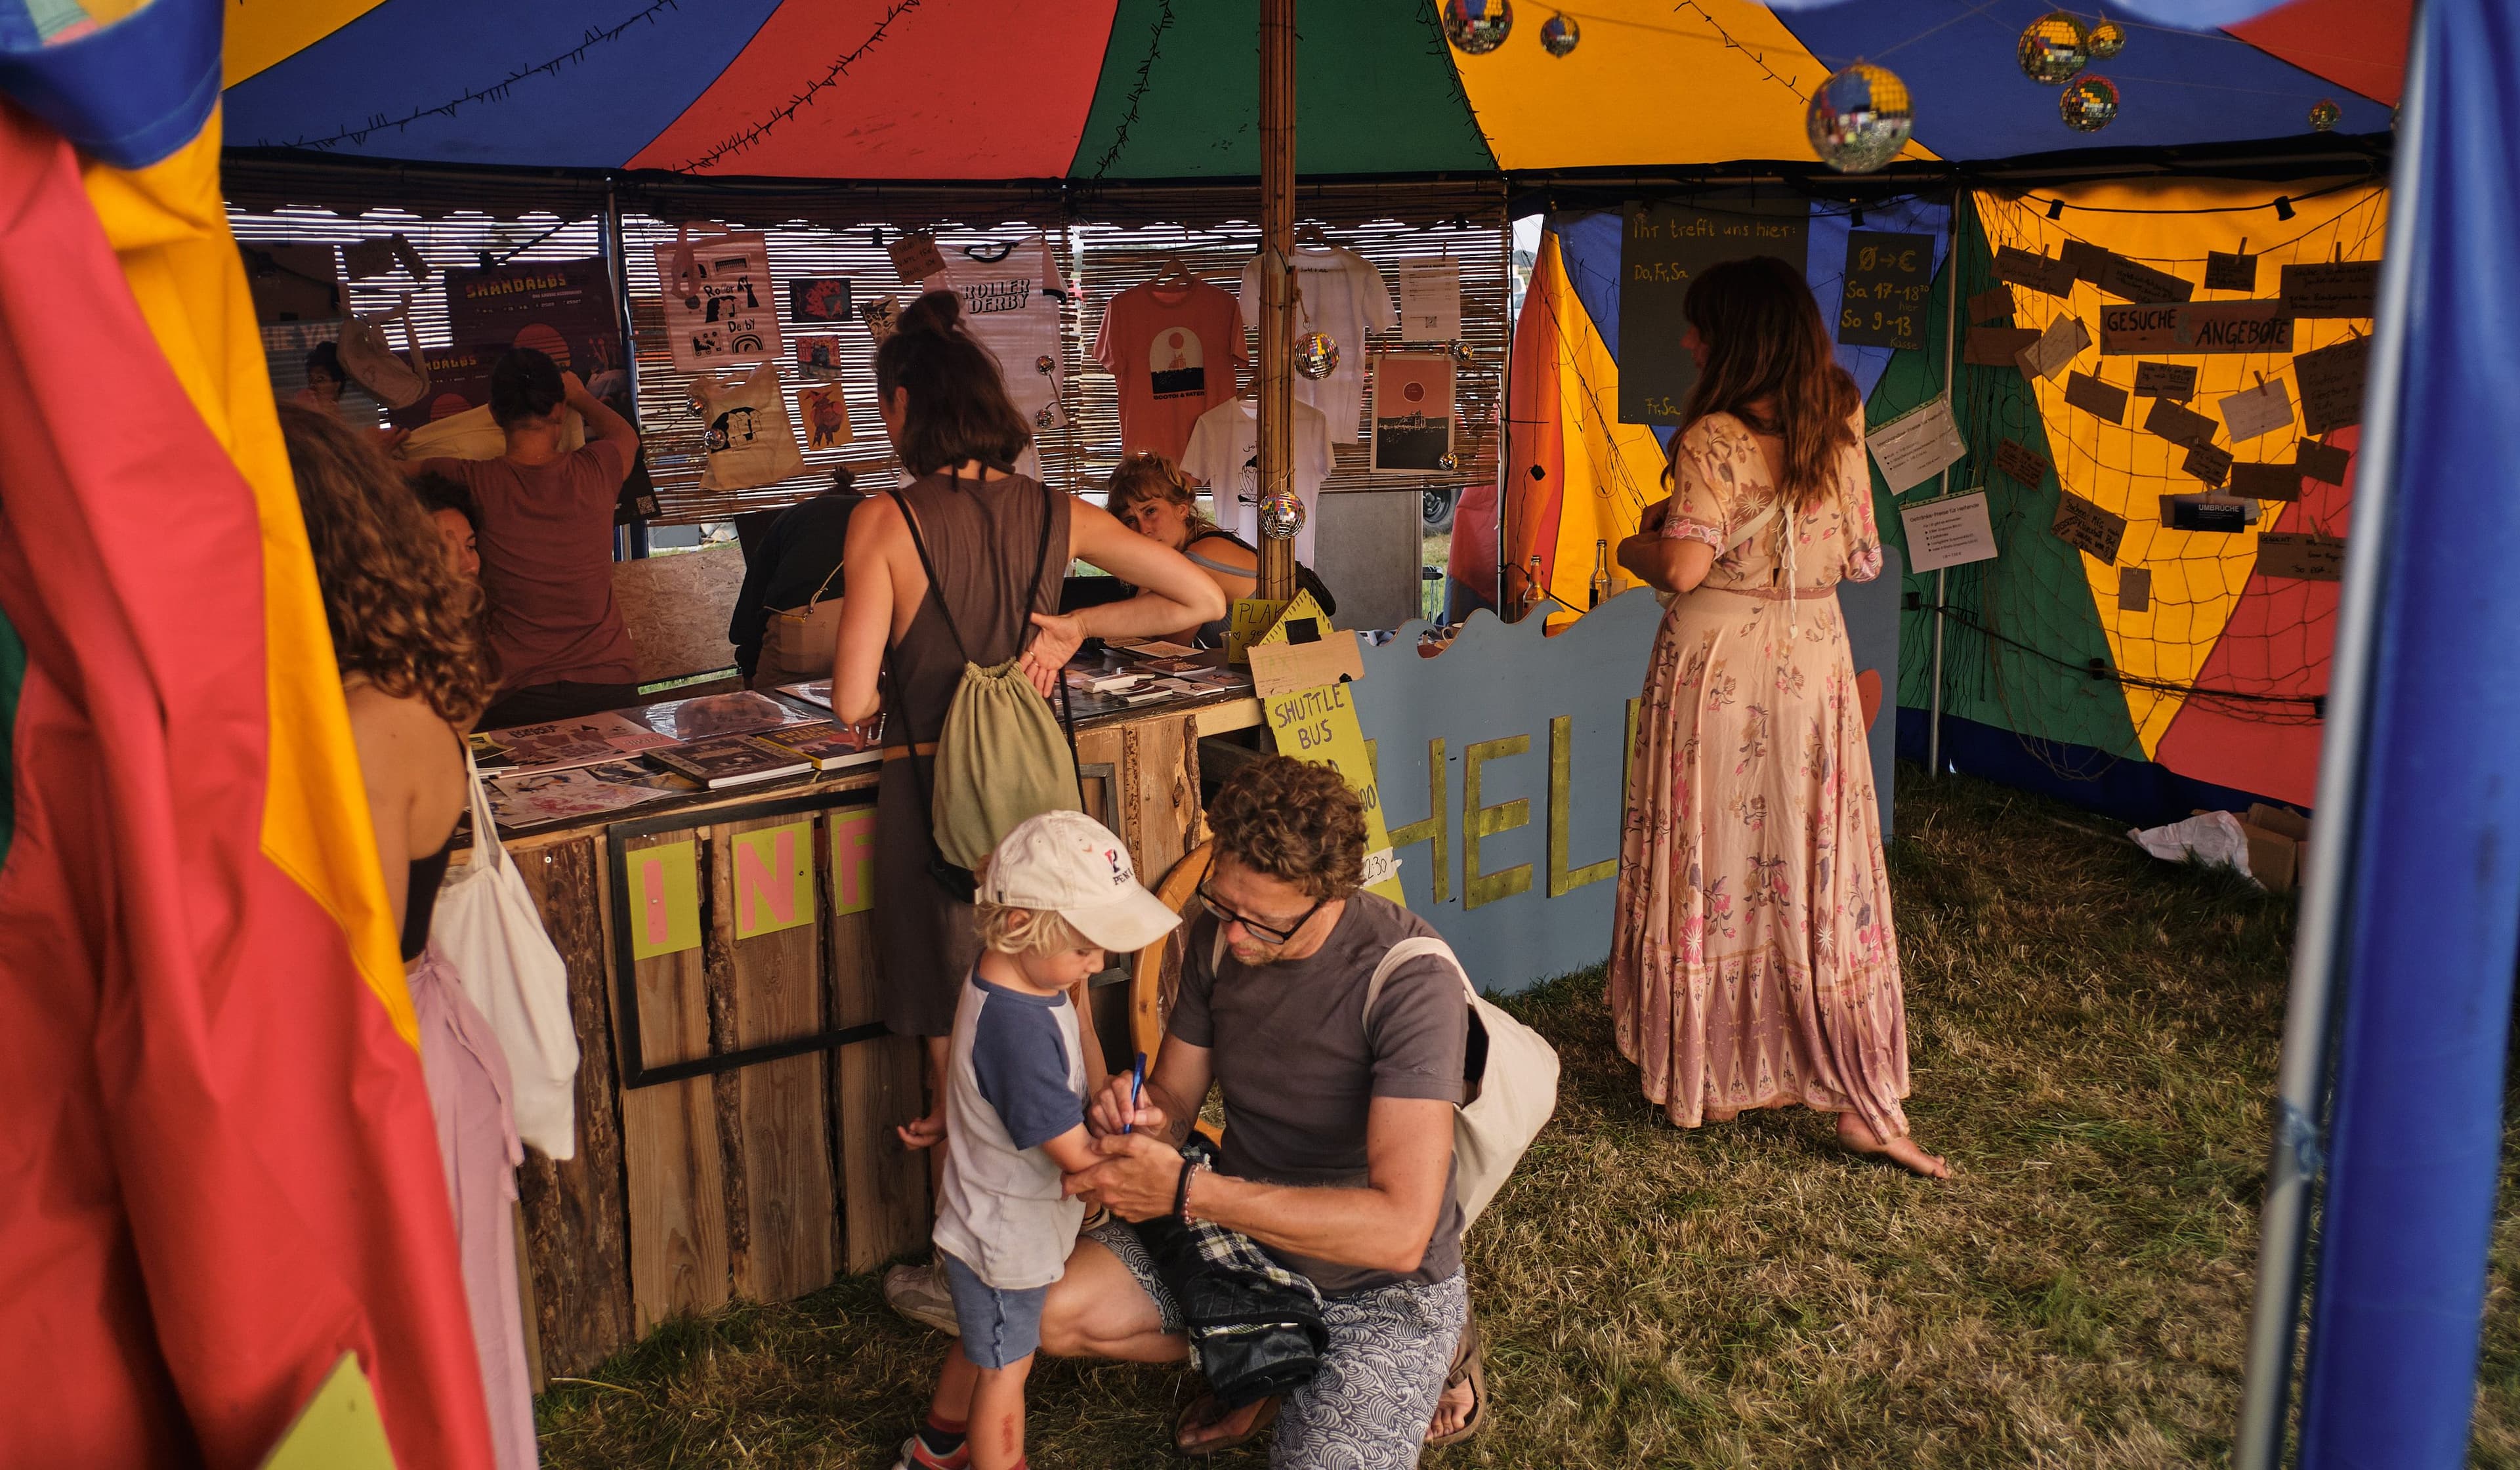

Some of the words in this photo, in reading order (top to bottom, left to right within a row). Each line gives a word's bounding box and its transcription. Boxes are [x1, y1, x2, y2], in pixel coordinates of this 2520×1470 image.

[1634, 218, 1659, 238] Ihr
[1671, 218, 1715, 238] trefft
[1724, 225, 1749, 236] uns
[1757, 220, 1796, 238] hier:
[962, 278, 1030, 299] ROLLER
[1846, 280, 1868, 299] Sa
[969, 293, 1029, 314] DERBY
[1841, 309, 1862, 327] So
[2107, 308, 2177, 331] GESUCHE
[2195, 318, 2290, 348] ANGEBOTE
[1274, 682, 1345, 728] SHUTTLE
[1297, 719, 1333, 749] BUS
[1364, 697, 1642, 911] HEL
[1365, 856, 1387, 879] 2:30
[643, 818, 877, 945] INF
